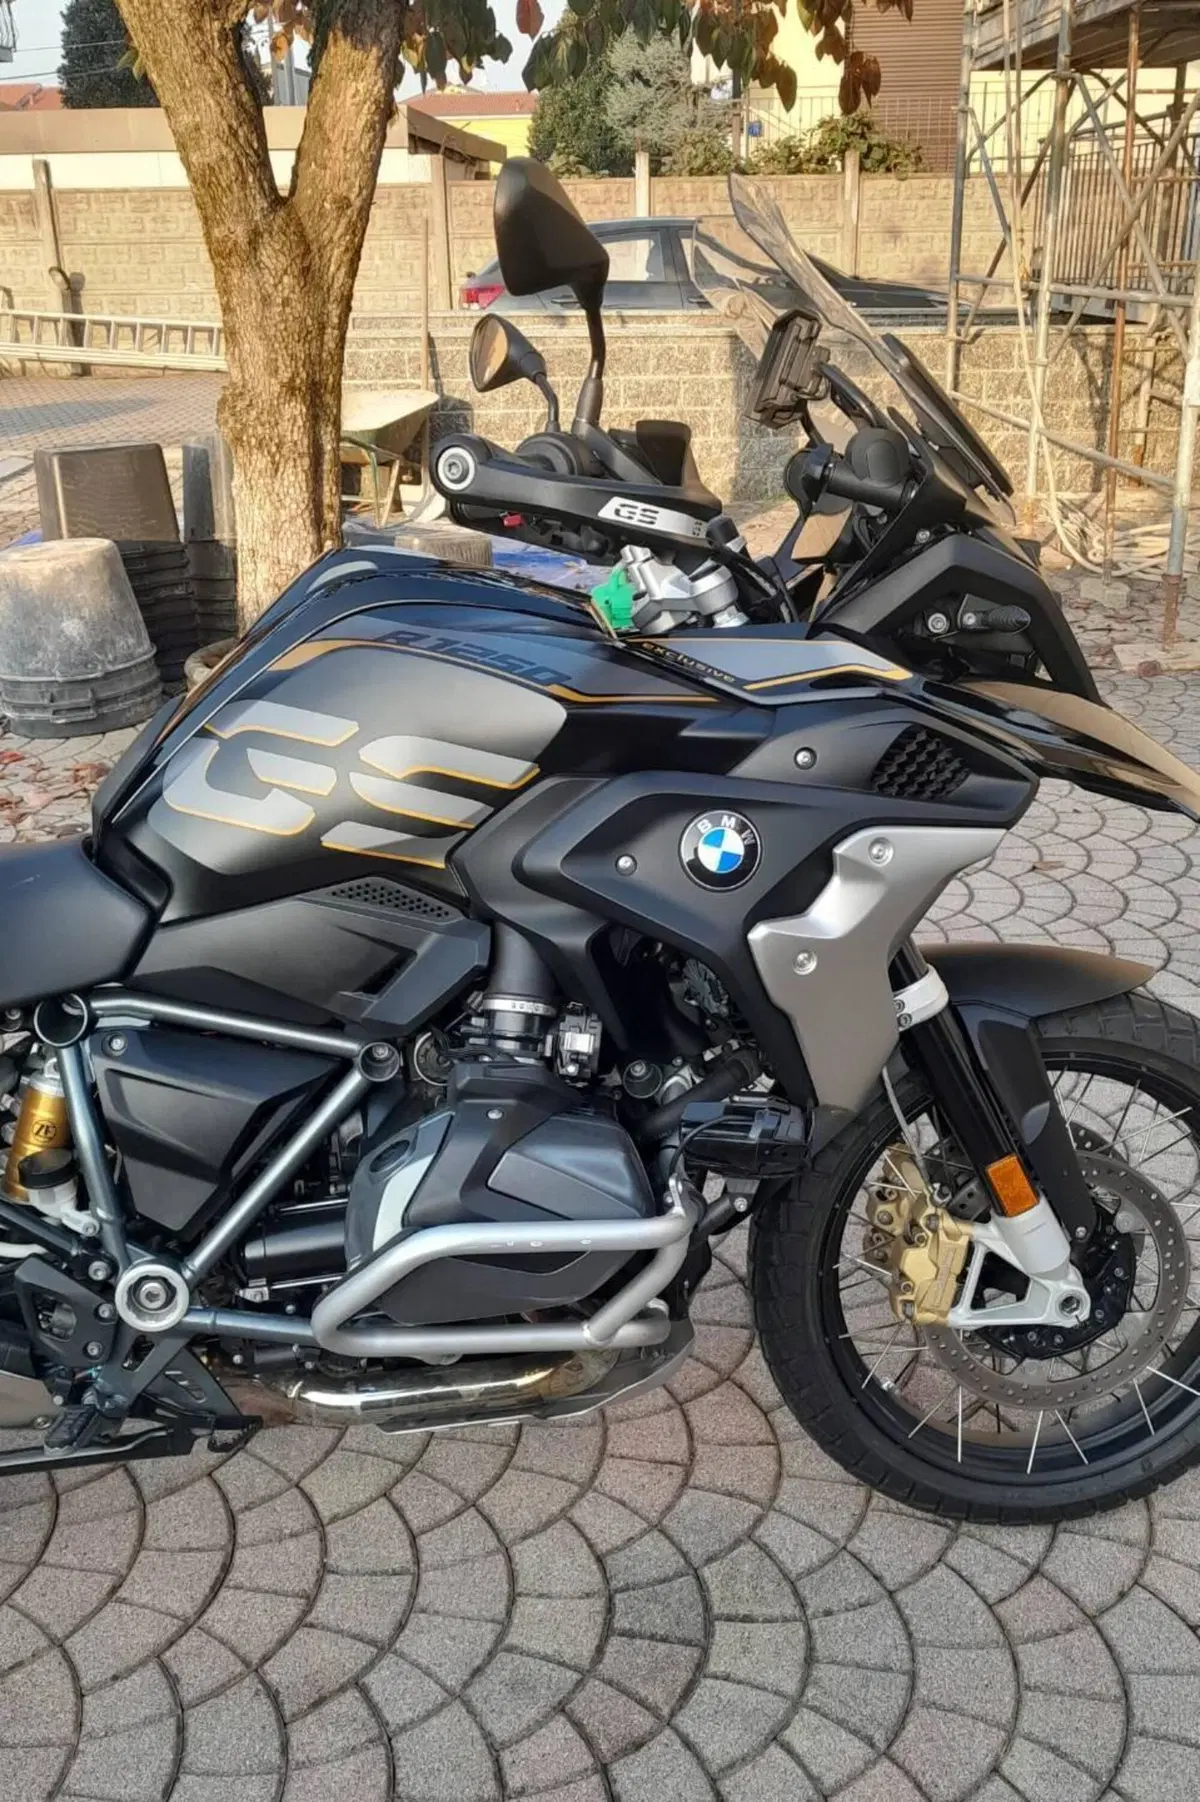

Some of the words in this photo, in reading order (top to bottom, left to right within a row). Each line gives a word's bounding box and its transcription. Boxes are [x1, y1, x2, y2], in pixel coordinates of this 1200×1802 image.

[614, 503, 660, 525] GS
[162, 700, 540, 869] GS
[697, 815, 756, 846] BMW
